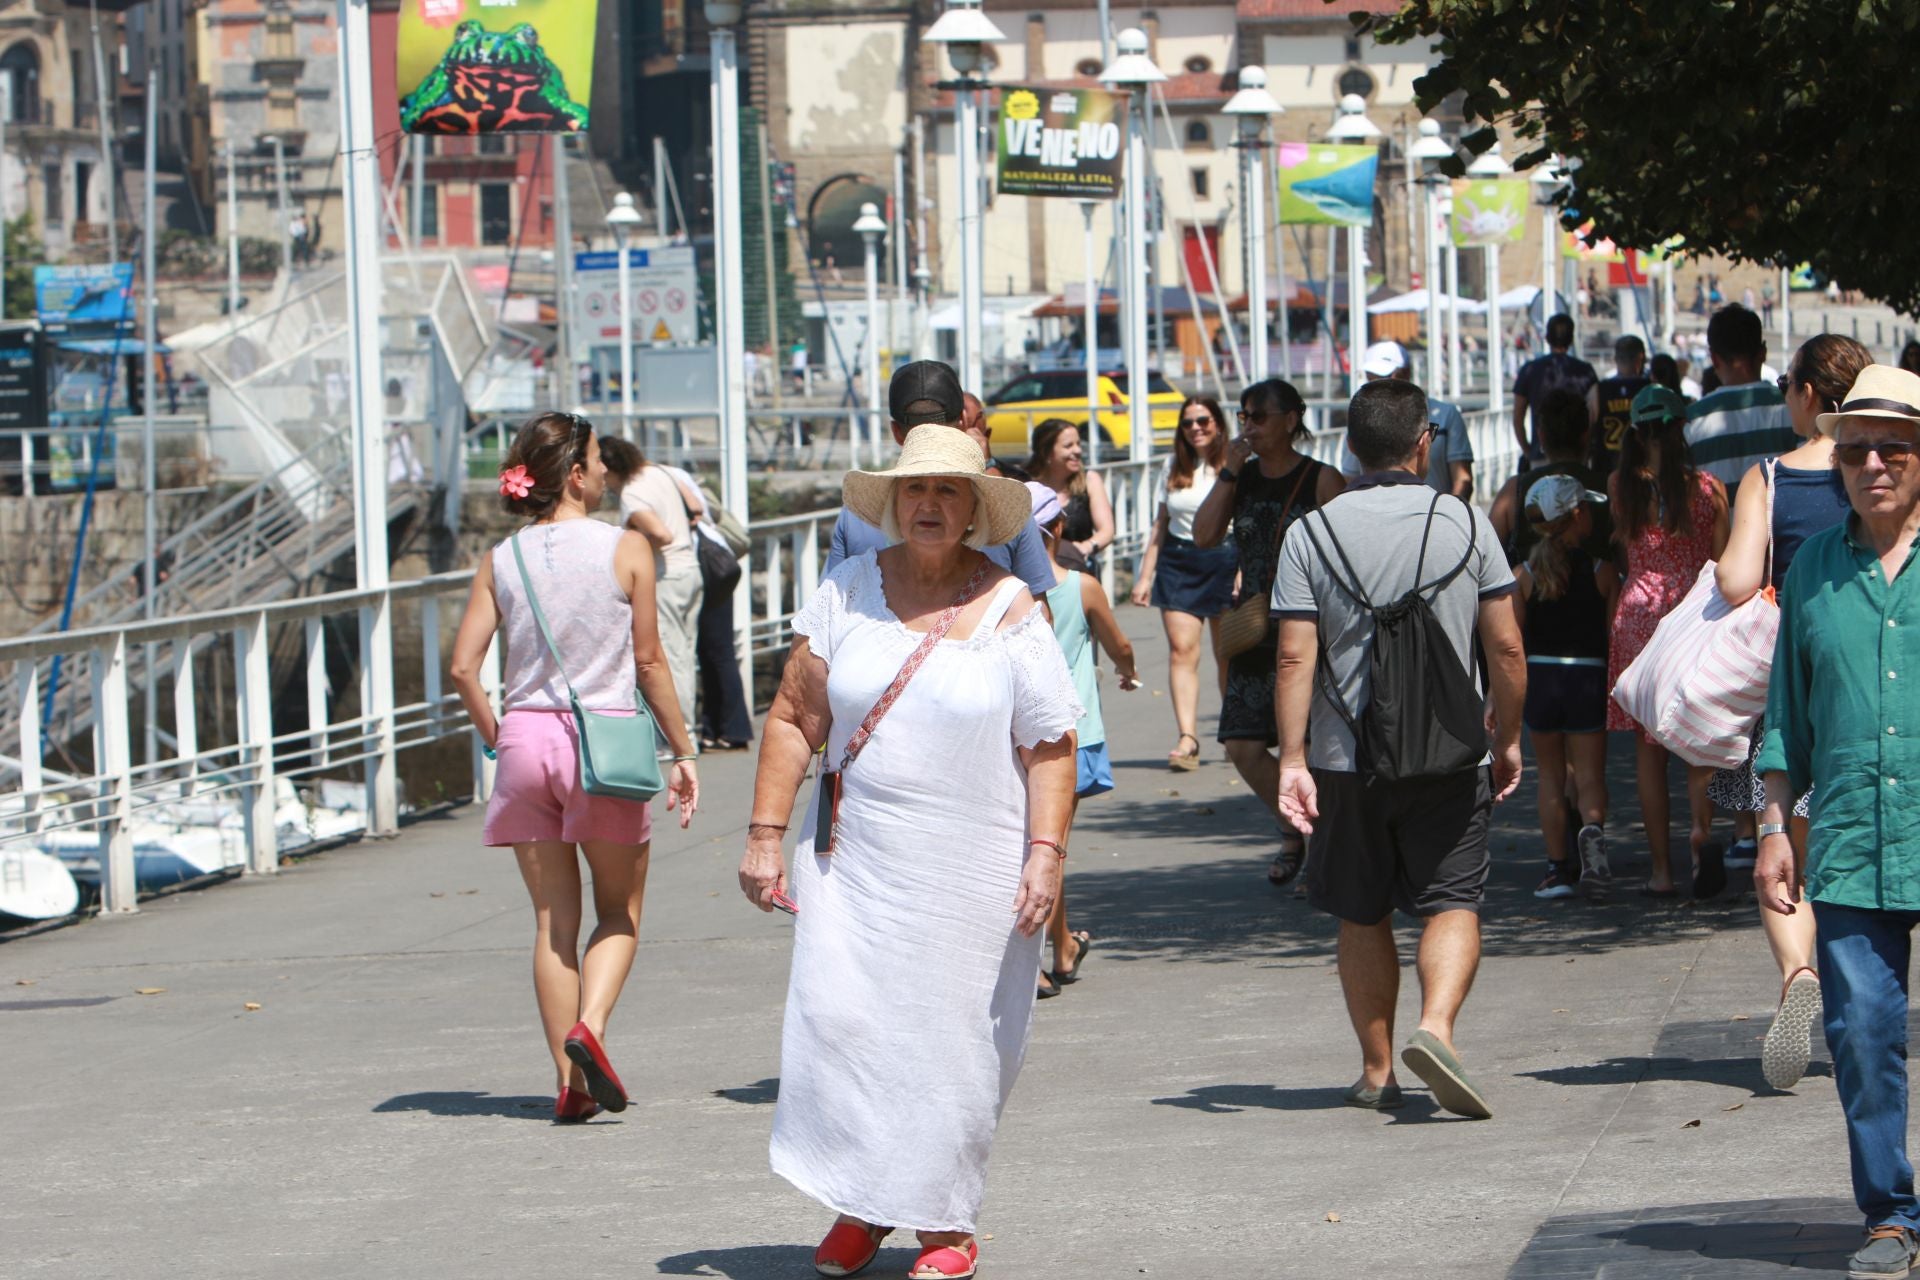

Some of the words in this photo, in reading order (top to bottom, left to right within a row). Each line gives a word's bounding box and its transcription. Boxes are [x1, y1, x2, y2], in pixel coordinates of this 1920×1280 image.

[1004, 118, 1120, 167] VENENO
[1003, 170, 1076, 182] NATURALEZA
[1079, 173, 1114, 184] LETAL
